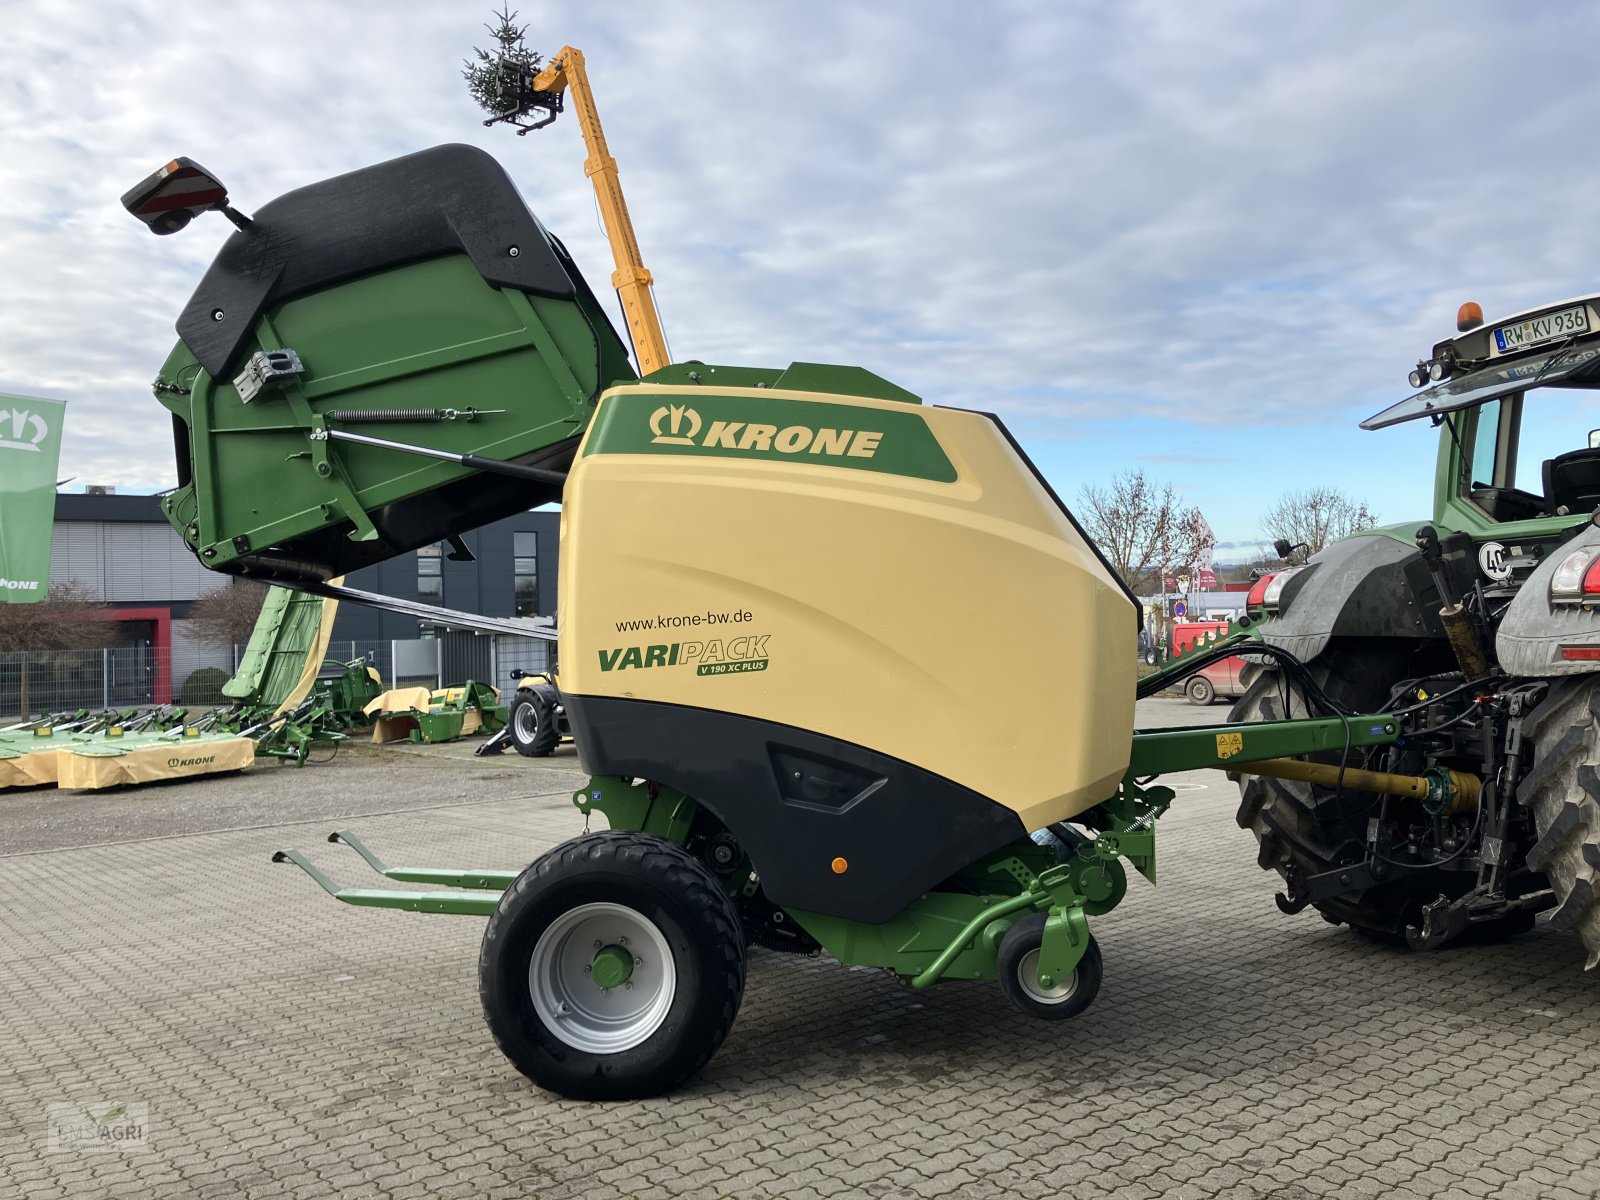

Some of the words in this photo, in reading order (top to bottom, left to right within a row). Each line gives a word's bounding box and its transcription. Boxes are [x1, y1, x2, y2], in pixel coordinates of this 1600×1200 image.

[1503, 326, 1524, 346] RW
[1532, 318, 1552, 339] KV
[1554, 310, 1585, 333] 936
[701, 421, 884, 458] KRONE
[1487, 548, 1511, 573] 40
[615, 609, 753, 632] www.krone-bw.de
[598, 634, 772, 672] VARIPACK
[701, 666, 708, 674] V
[711, 665, 726, 673] 190
[728, 664, 741, 672] XC
[742, 661, 764, 670] PLUS
[179, 755, 216, 767] KRONE
